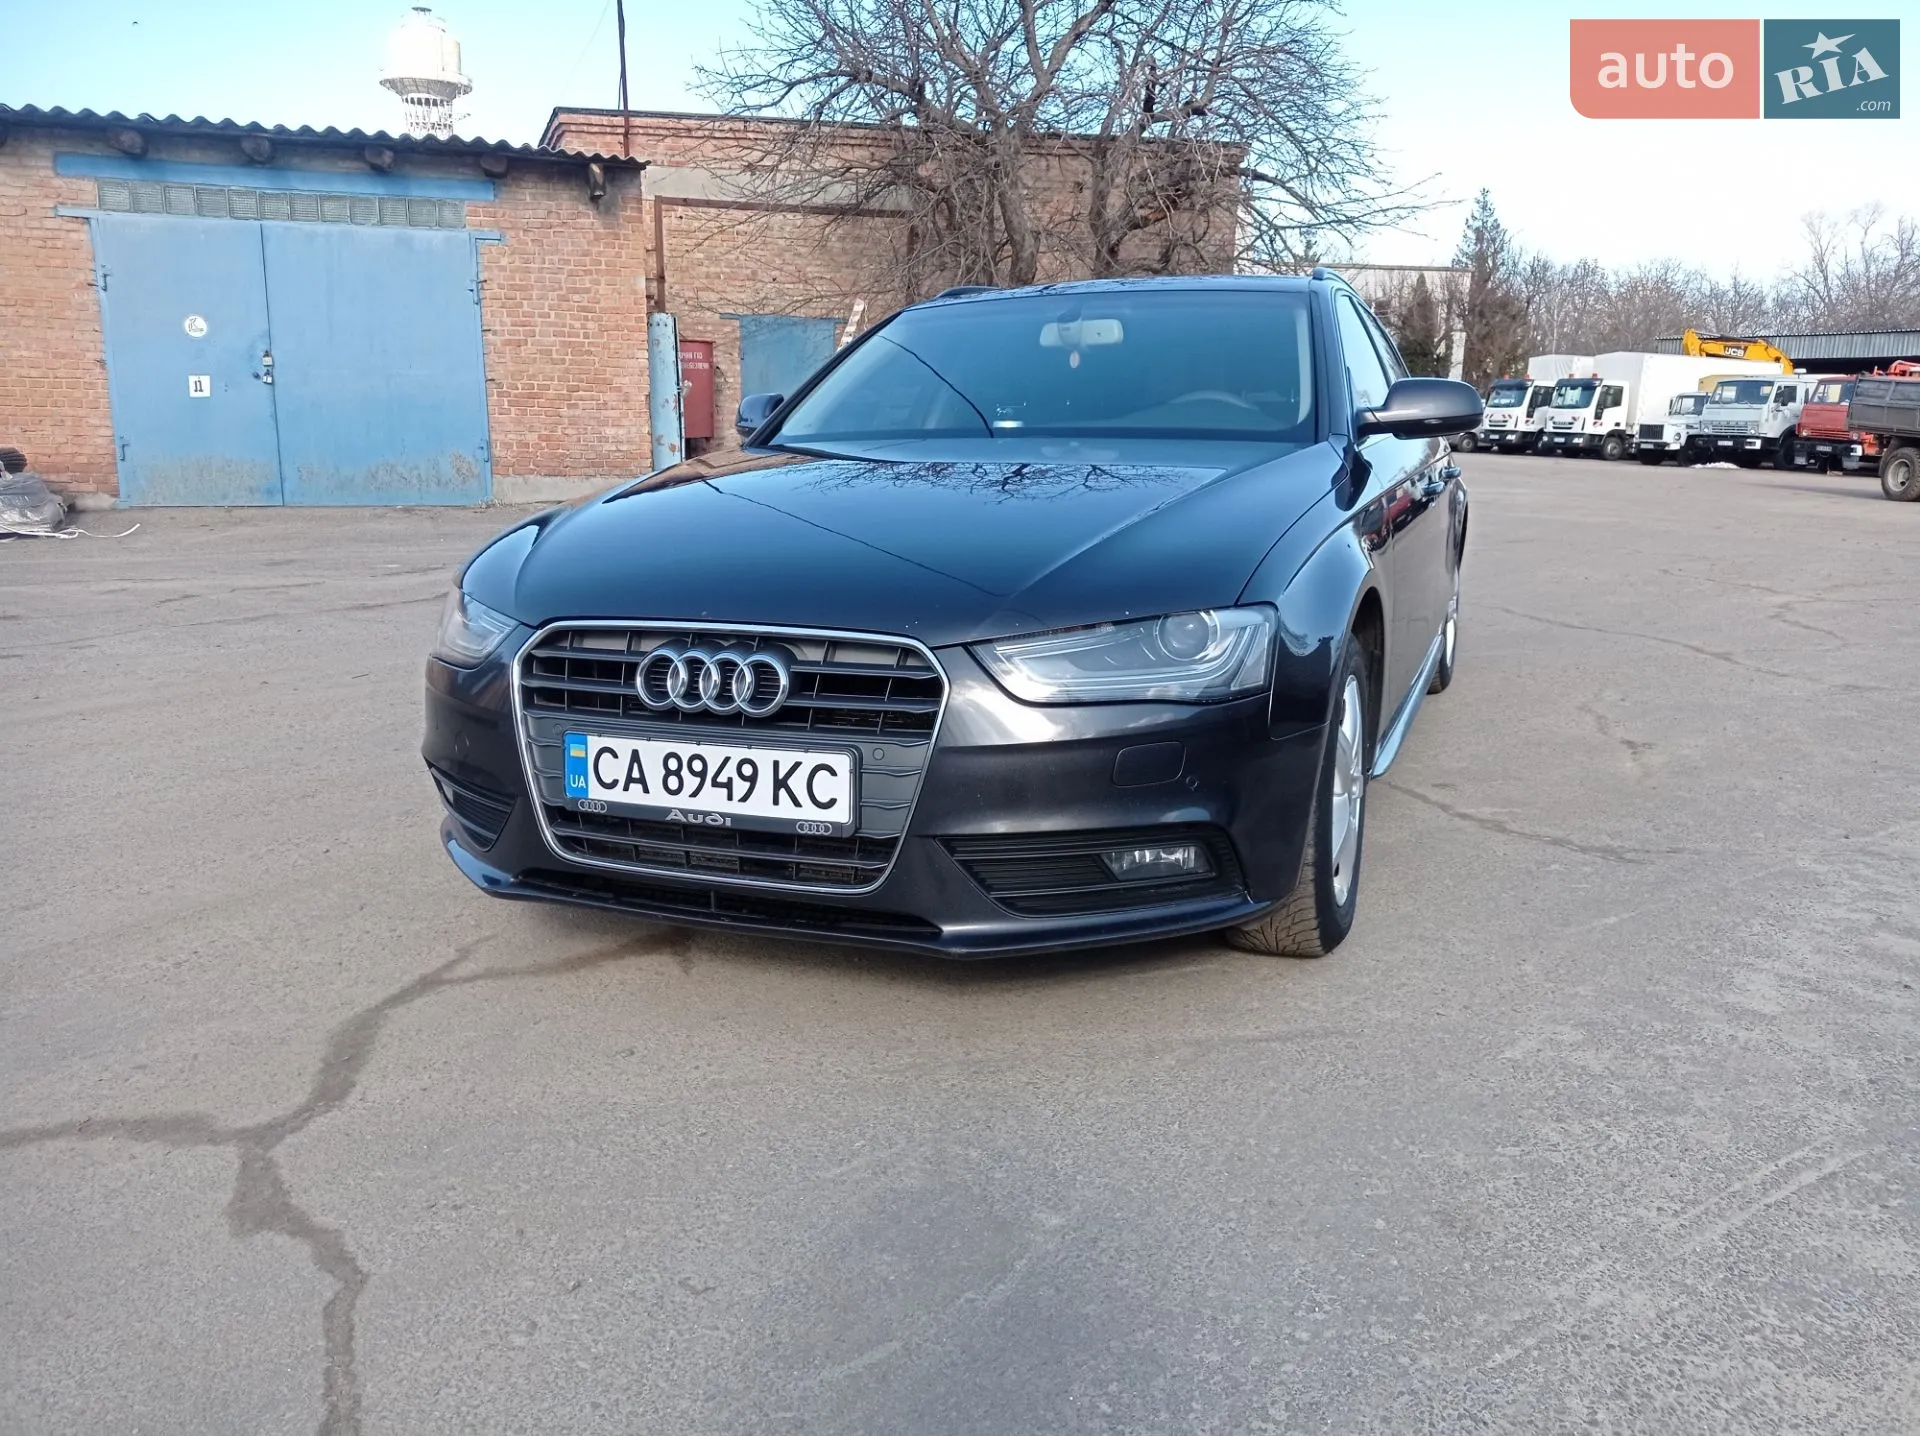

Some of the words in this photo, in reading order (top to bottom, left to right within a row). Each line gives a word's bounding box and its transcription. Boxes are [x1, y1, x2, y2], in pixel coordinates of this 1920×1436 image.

[1724, 346, 1745, 357] JCB
[570, 775, 587, 789] UA
[593, 746, 650, 794] CA
[662, 751, 759, 803] 8949
[772, 759, 838, 811] KC
